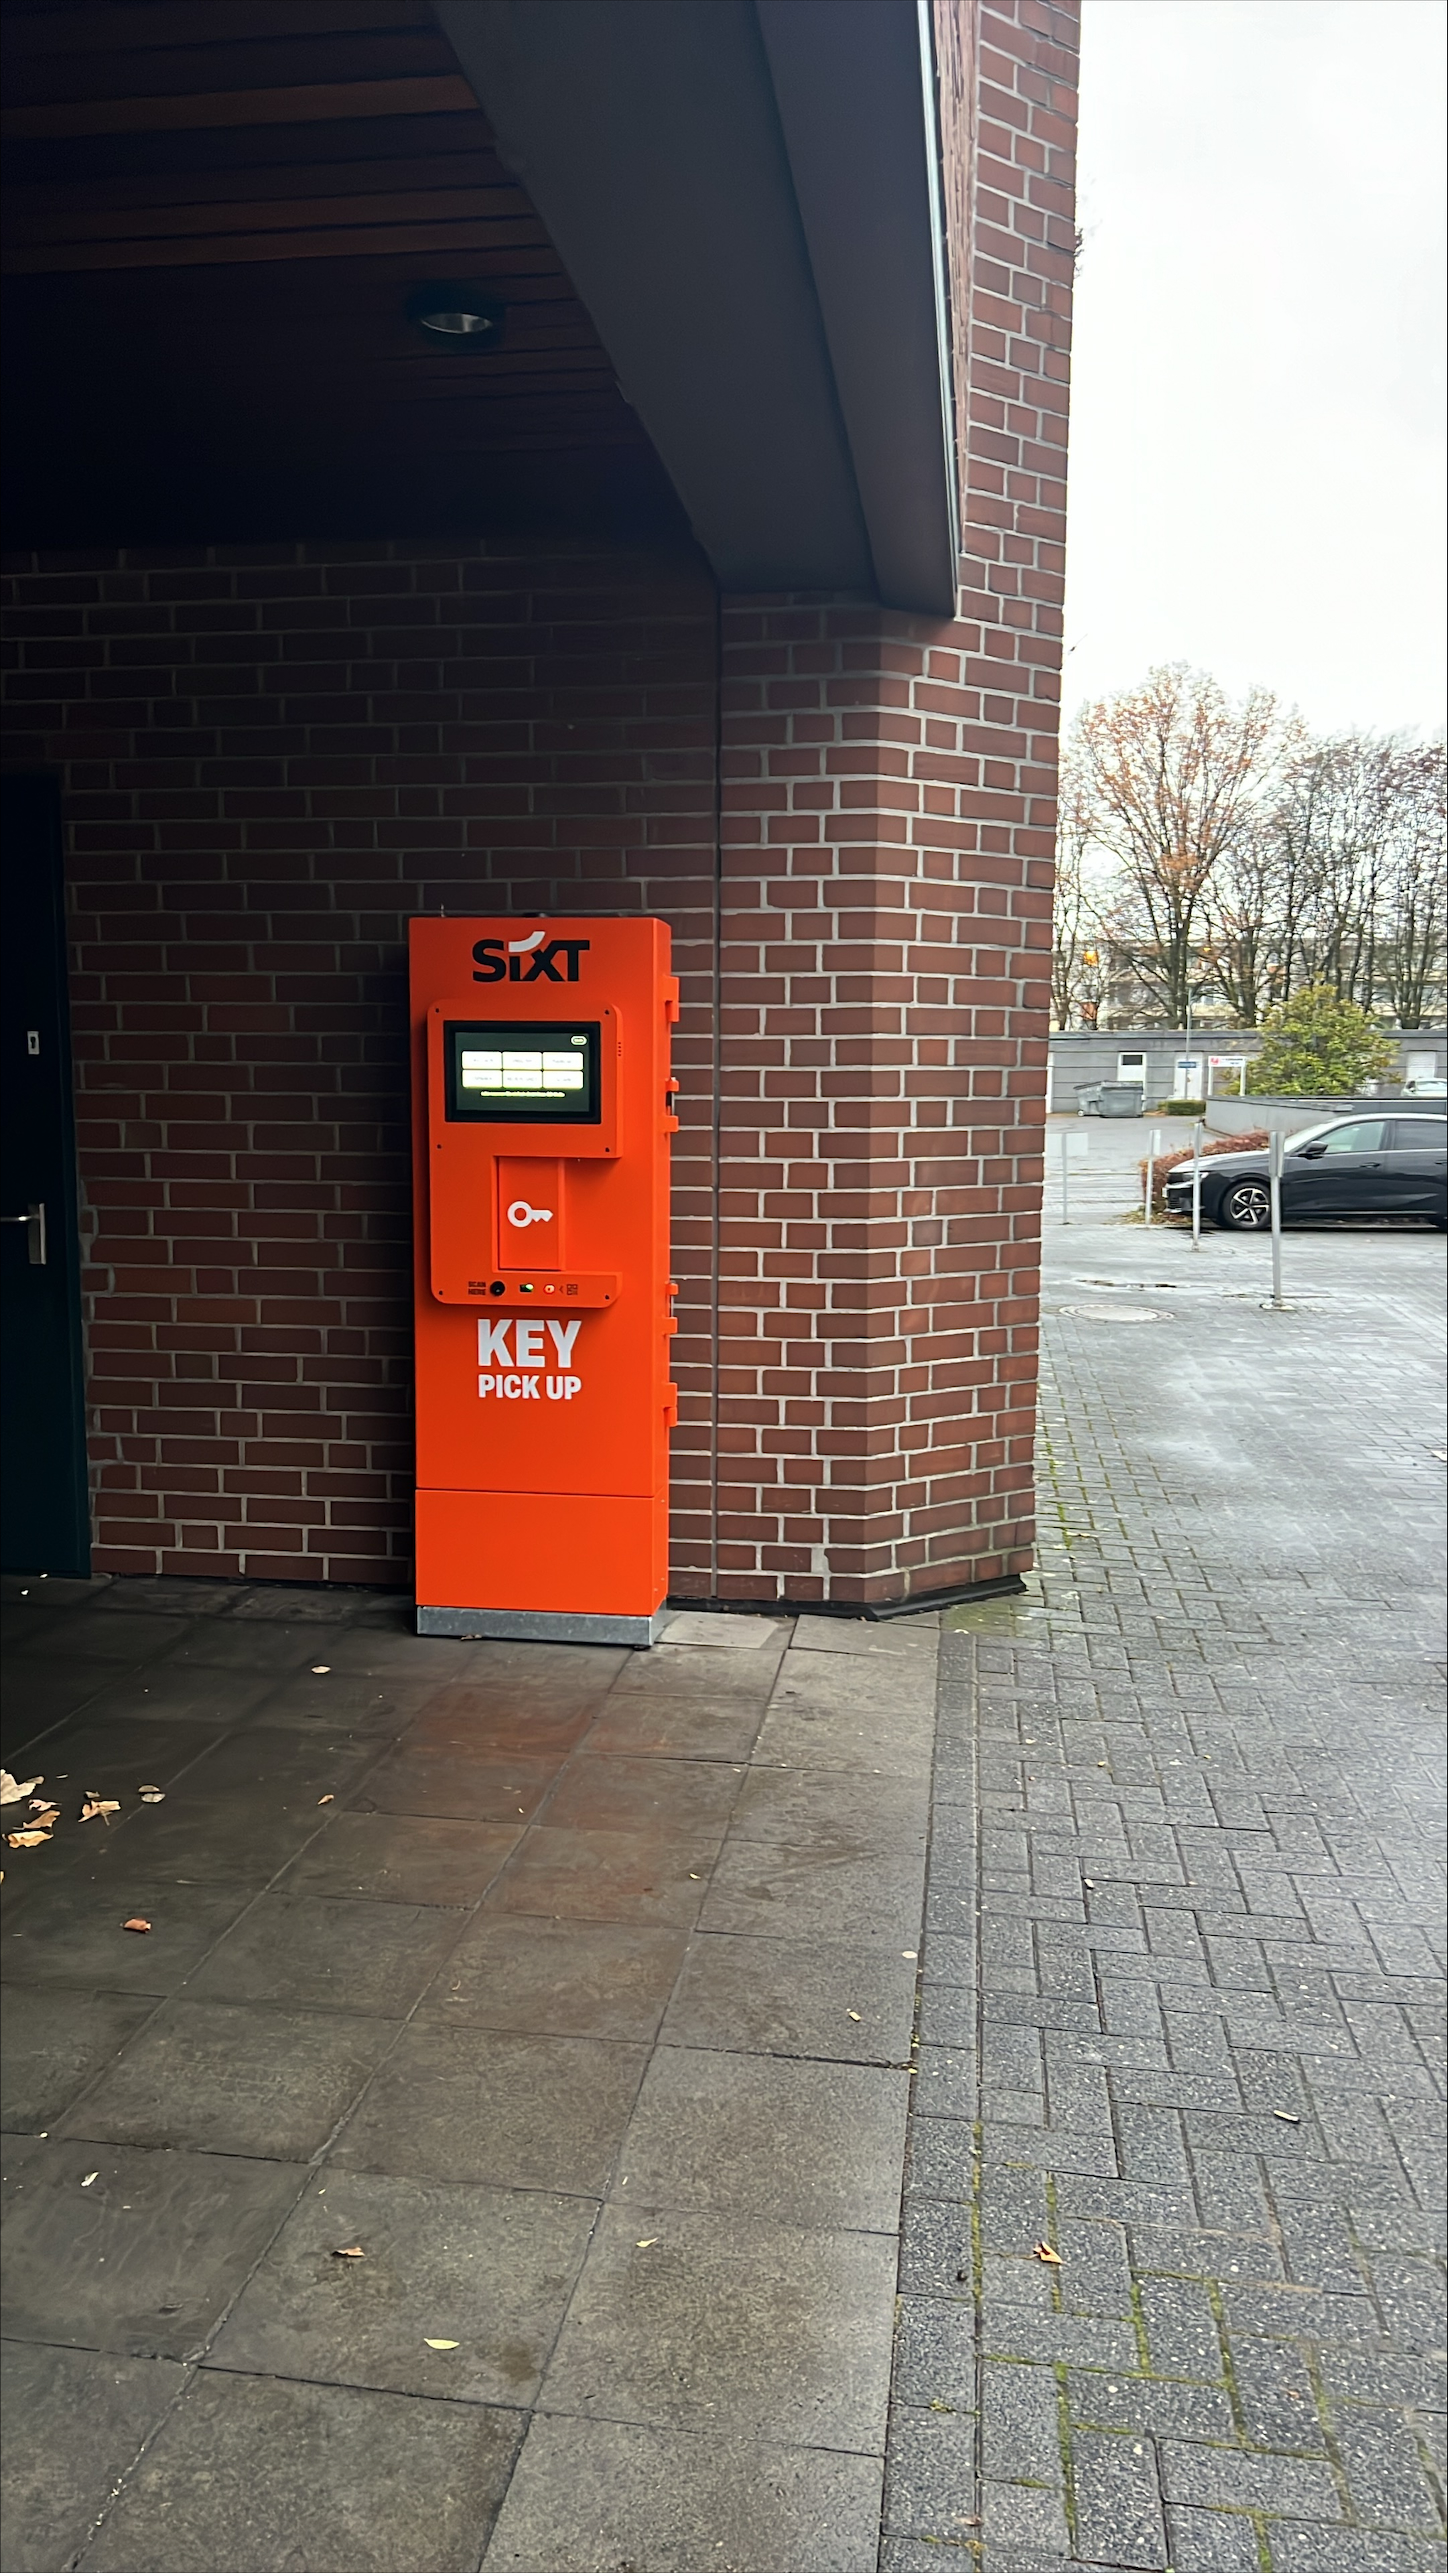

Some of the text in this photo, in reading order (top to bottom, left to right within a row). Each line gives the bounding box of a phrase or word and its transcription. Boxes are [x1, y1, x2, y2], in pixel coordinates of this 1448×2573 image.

[477, 1318, 582, 1368] KEY
[478, 1374, 582, 1400] PICK UP
